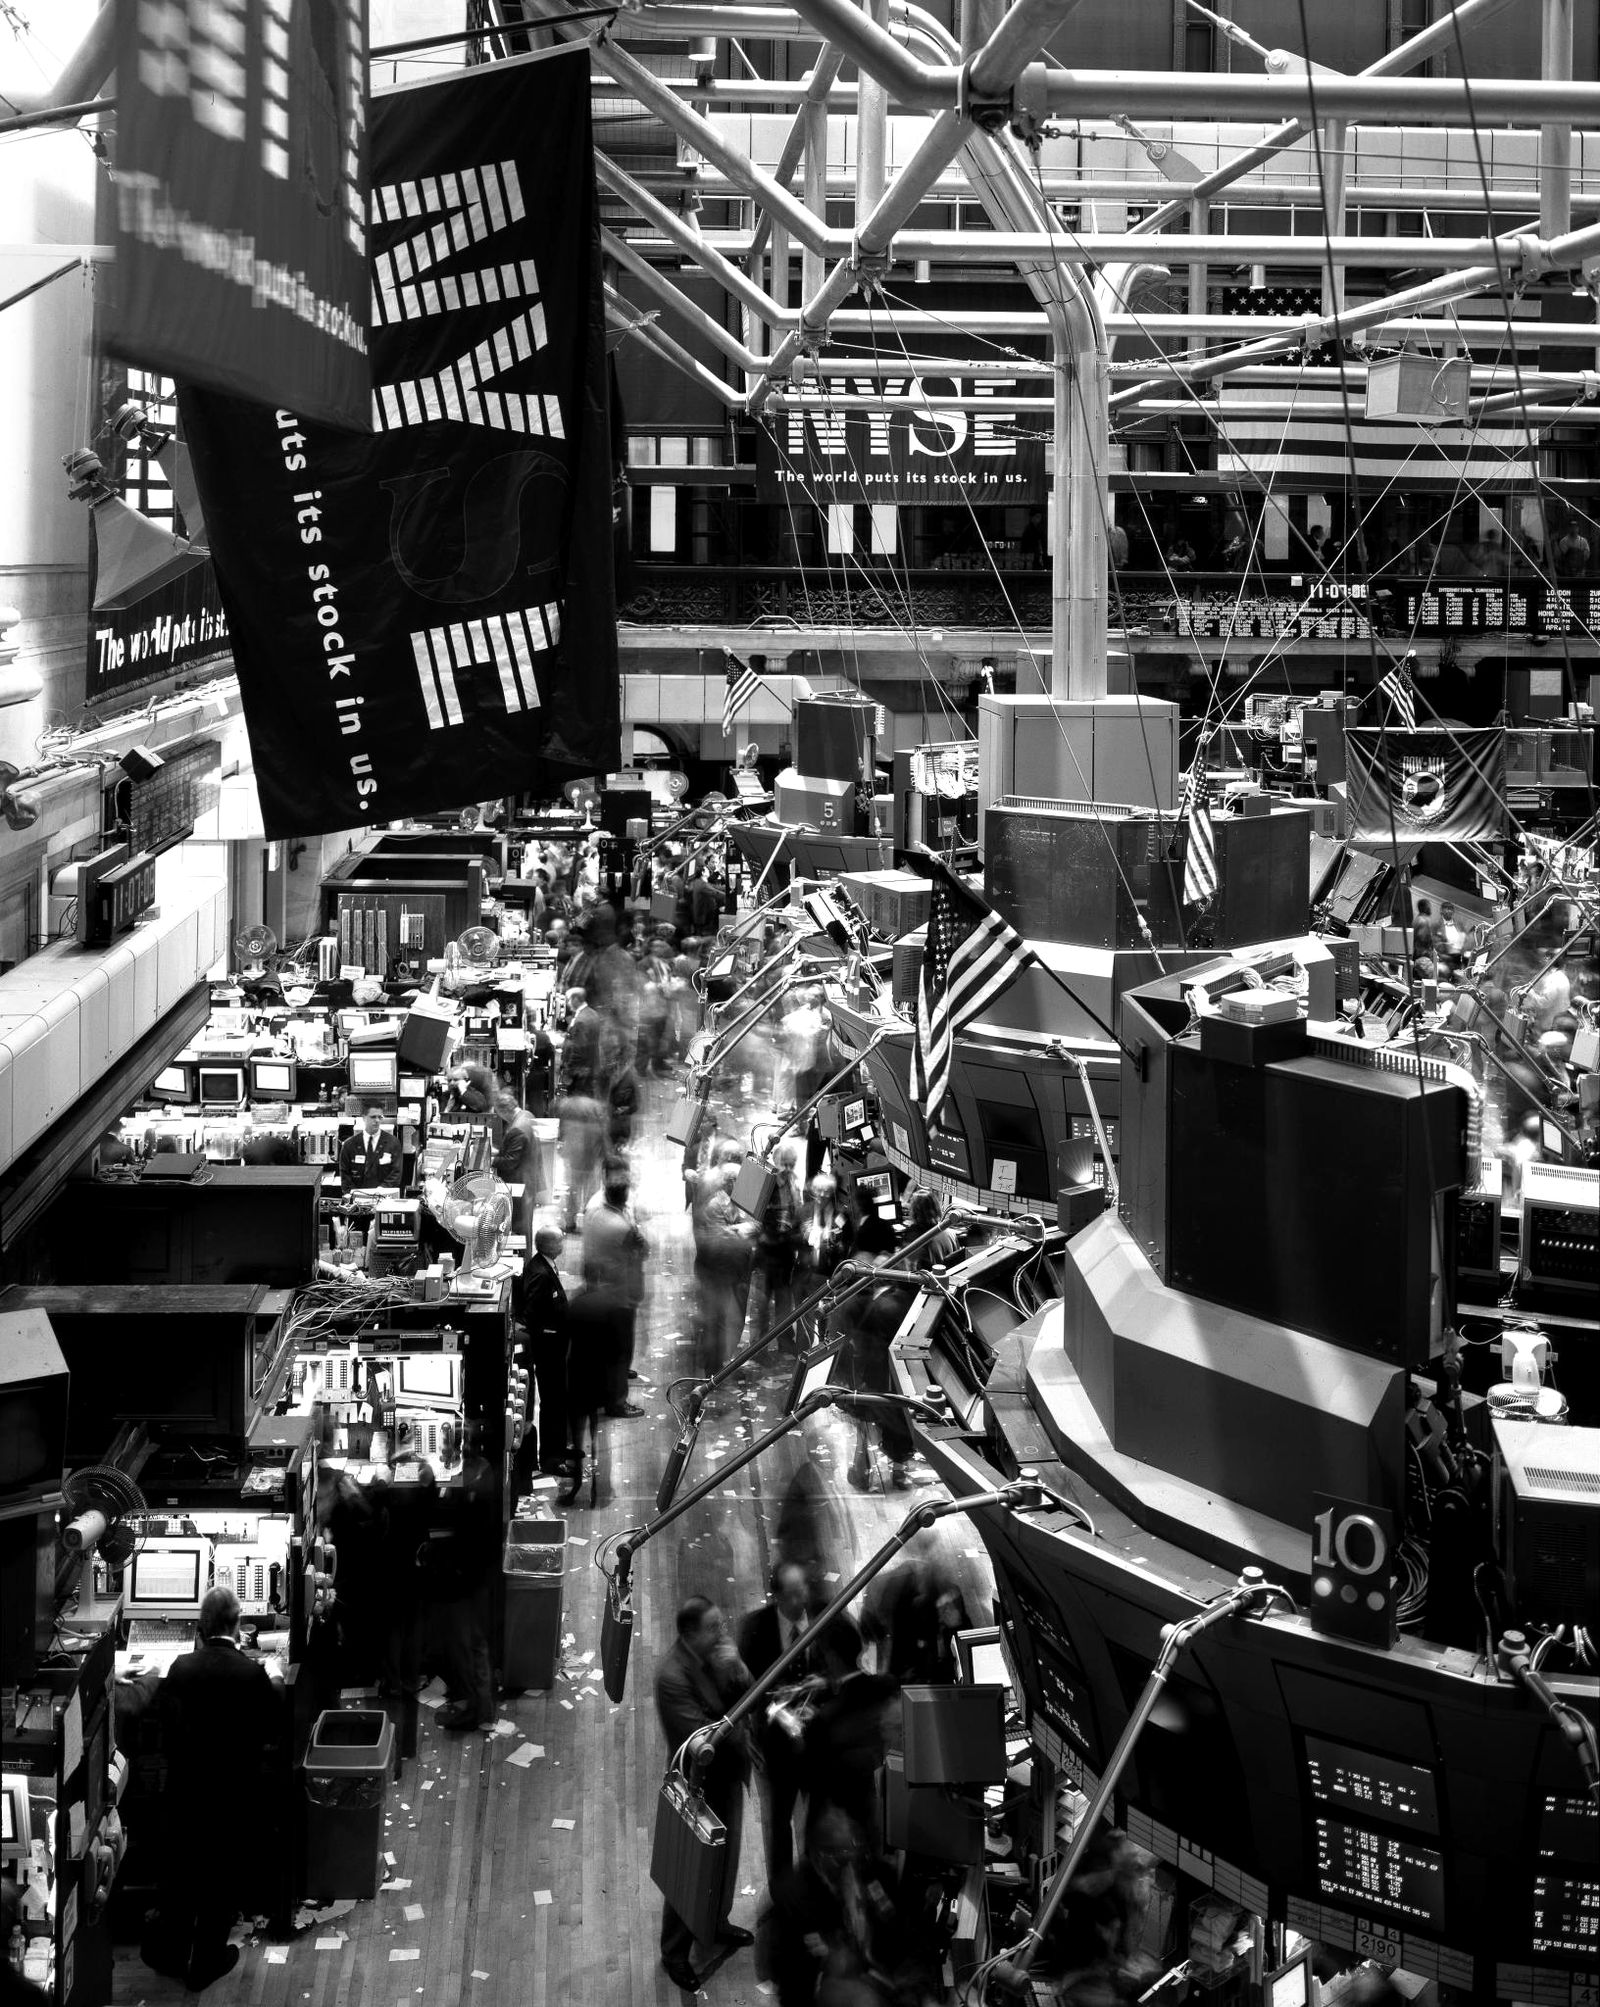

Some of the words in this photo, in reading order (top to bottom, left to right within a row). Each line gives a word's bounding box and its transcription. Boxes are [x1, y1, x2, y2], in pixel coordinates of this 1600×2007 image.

[788, 377, 1016, 456] NYSE
[775, 470, 805, 483] The
[813, 470, 857, 483] world
[865, 472, 899, 486] puts
[906, 471, 926, 484] its
[933, 471, 976, 484] stock
[984, 471, 998, 484] in
[1005, 473, 1027, 484] us.
[276, 408, 307, 471] uts
[293, 490, 322, 544] its
[308, 563, 356, 680] stock
[335, 696, 365, 735] in
[350, 753, 377, 810] us.
[96, 627, 125, 673] The
[130, 615, 172, 663] world
[824, 802, 834, 818] 5
[1313, 1507, 1385, 1575] 10
[1361, 1935, 1396, 1958] 2190
